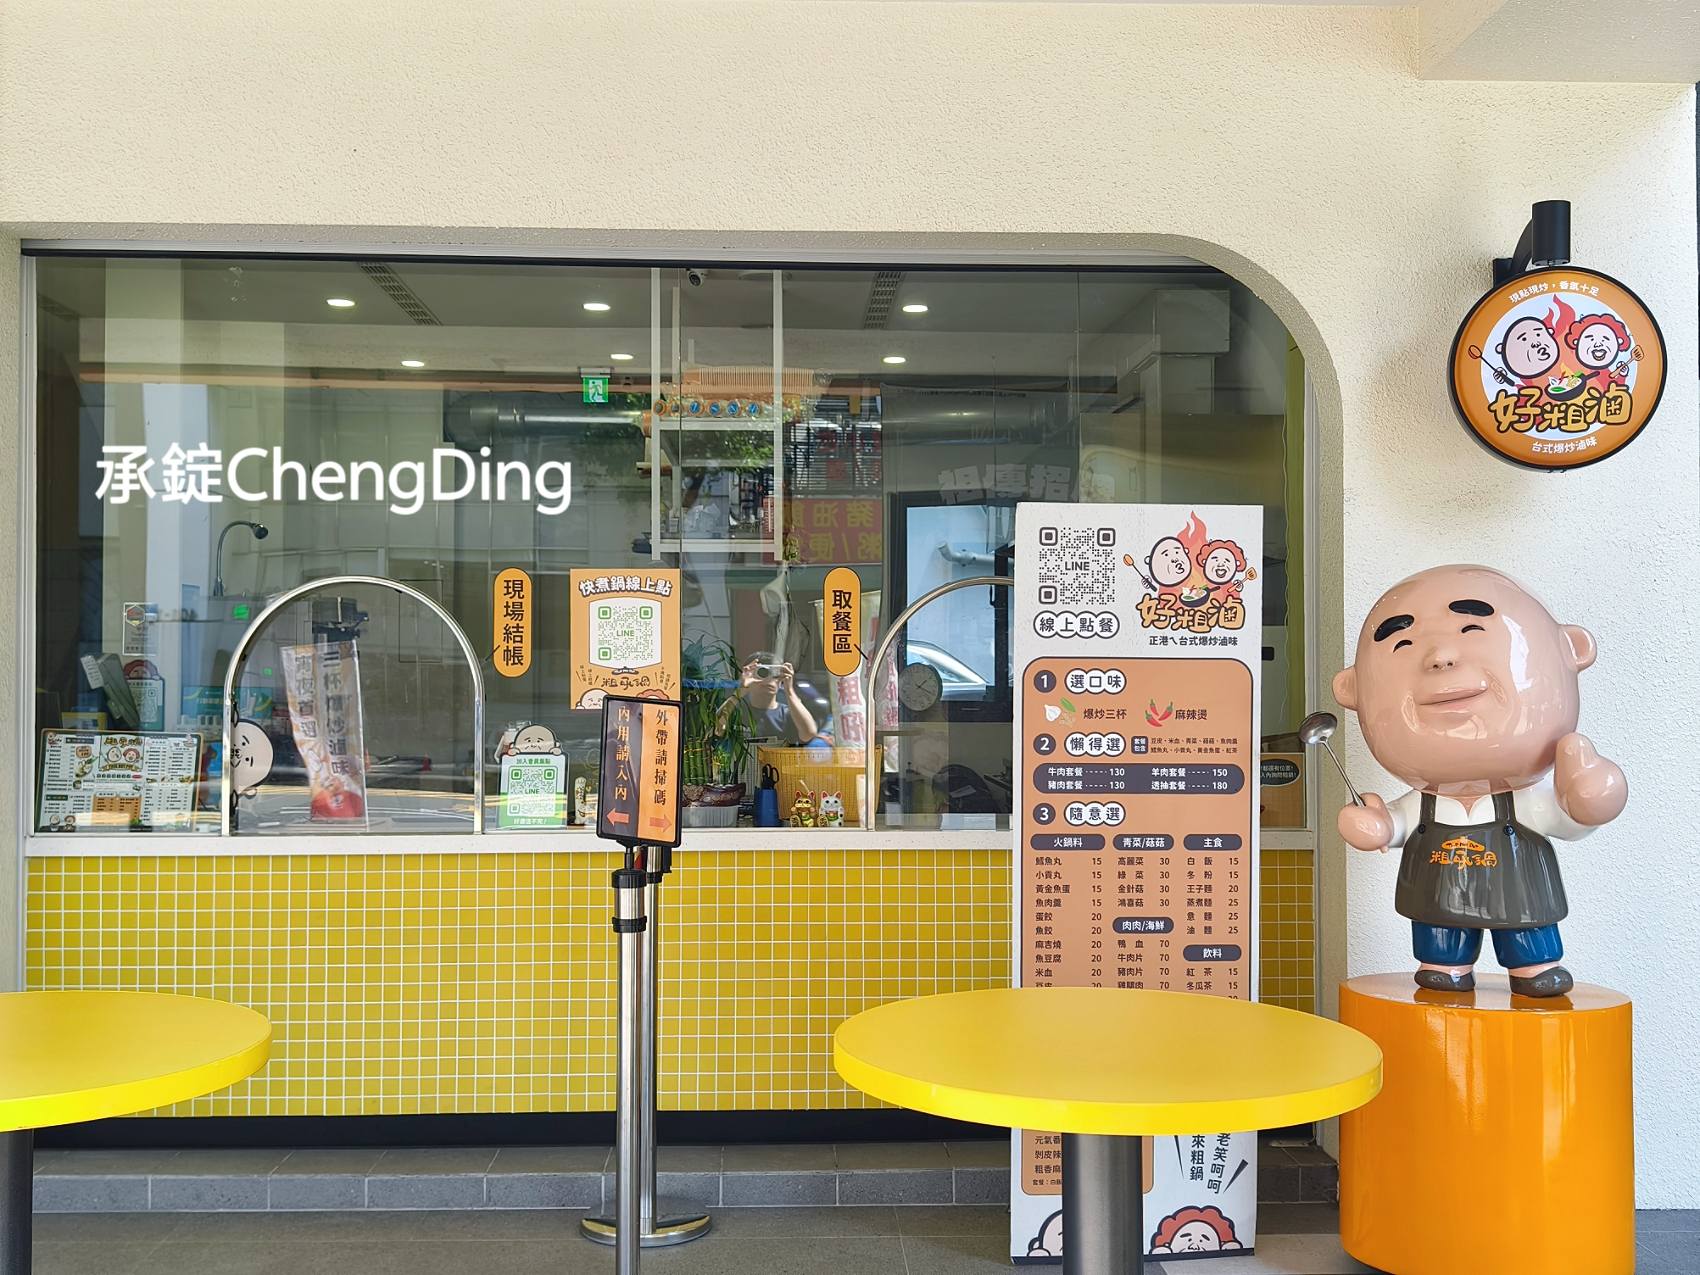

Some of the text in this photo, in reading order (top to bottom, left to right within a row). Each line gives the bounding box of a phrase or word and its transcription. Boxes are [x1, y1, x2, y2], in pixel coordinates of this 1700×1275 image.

[1532, 436, 1598, 454] 台式爆炒滷味
[1064, 561, 1090, 571] LINE
[580, 576, 672, 597] 快煮鍋線上點
[503, 579, 525, 666] 現場結帳
[832, 590, 853, 654] 取餐區
[1039, 617, 1114, 633] 線上點餐
[1041, 675, 1122, 689] 1 選口味
[1083, 708, 1127, 720] 爆炒三杯
[1175, 709, 1208, 720] 麻辣燙
[1041, 737, 1121, 751] 2 懶得選
[615, 706, 630, 801] 內用請入內
[653, 708, 669, 806] 外帶請掃碼
[1048, 768, 1125, 777] 牛肉套餐 130
[1152, 768, 1228, 777] 羊肉套餐 150
[1048, 781, 1125, 790] 豬肉套餐 130
[1151, 781, 1228, 790] 透抽套餐 180
[1040, 807, 1120, 821] 3 隨意選
[1053, 837, 1083, 847] 火鍋料
[1123, 837, 1165, 848] 青菜/菇菇
[1203, 837, 1223, 848] 主食
[1091, 858, 1102, 866] 15
[1117, 857, 1170, 866] 高麗菜 30
[1228, 858, 1239, 866] 15
[1091, 871, 1102, 880] 15
[1159, 871, 1170, 880] 30
[1228, 871, 1239, 880] 15
[1091, 885, 1102, 894] 15
[1117, 884, 1170, 894] 金針菇 30
[1187, 884, 1239, 894] 王子麵 20
[1091, 899, 1102, 908] 15
[1117, 898, 1170, 908] 鴻喜菇 30
[1228, 898, 1239, 907] 25
[1035, 912, 1102, 922] 蛋餃 20
[1228, 912, 1239, 921] 25
[1122, 920, 1165, 931] 肉肉/海鮮
[1035, 926, 1102, 935] 魚餃 20
[1228, 926, 1239, 935] 25
[1091, 940, 1102, 949] 20
[1159, 940, 1170, 948] 70
[1117, 953, 1170, 962] 牛肉片 70
[1203, 948, 1222, 958] 飲料
[1035, 954, 1102, 963] 魚豆腐 20
[1035, 968, 1102, 977] 米血 20
[1117, 967, 1170, 976] 豬肉片 70
[1228, 968, 1238, 976] 15
[1159, 981, 1170, 989] 70
[1186, 982, 1238, 990] 冬瓜茶 15
[1190, 1134, 1206, 1181] 來粗鍋
[1207, 1132, 1231, 1194] 老笑呵呵
